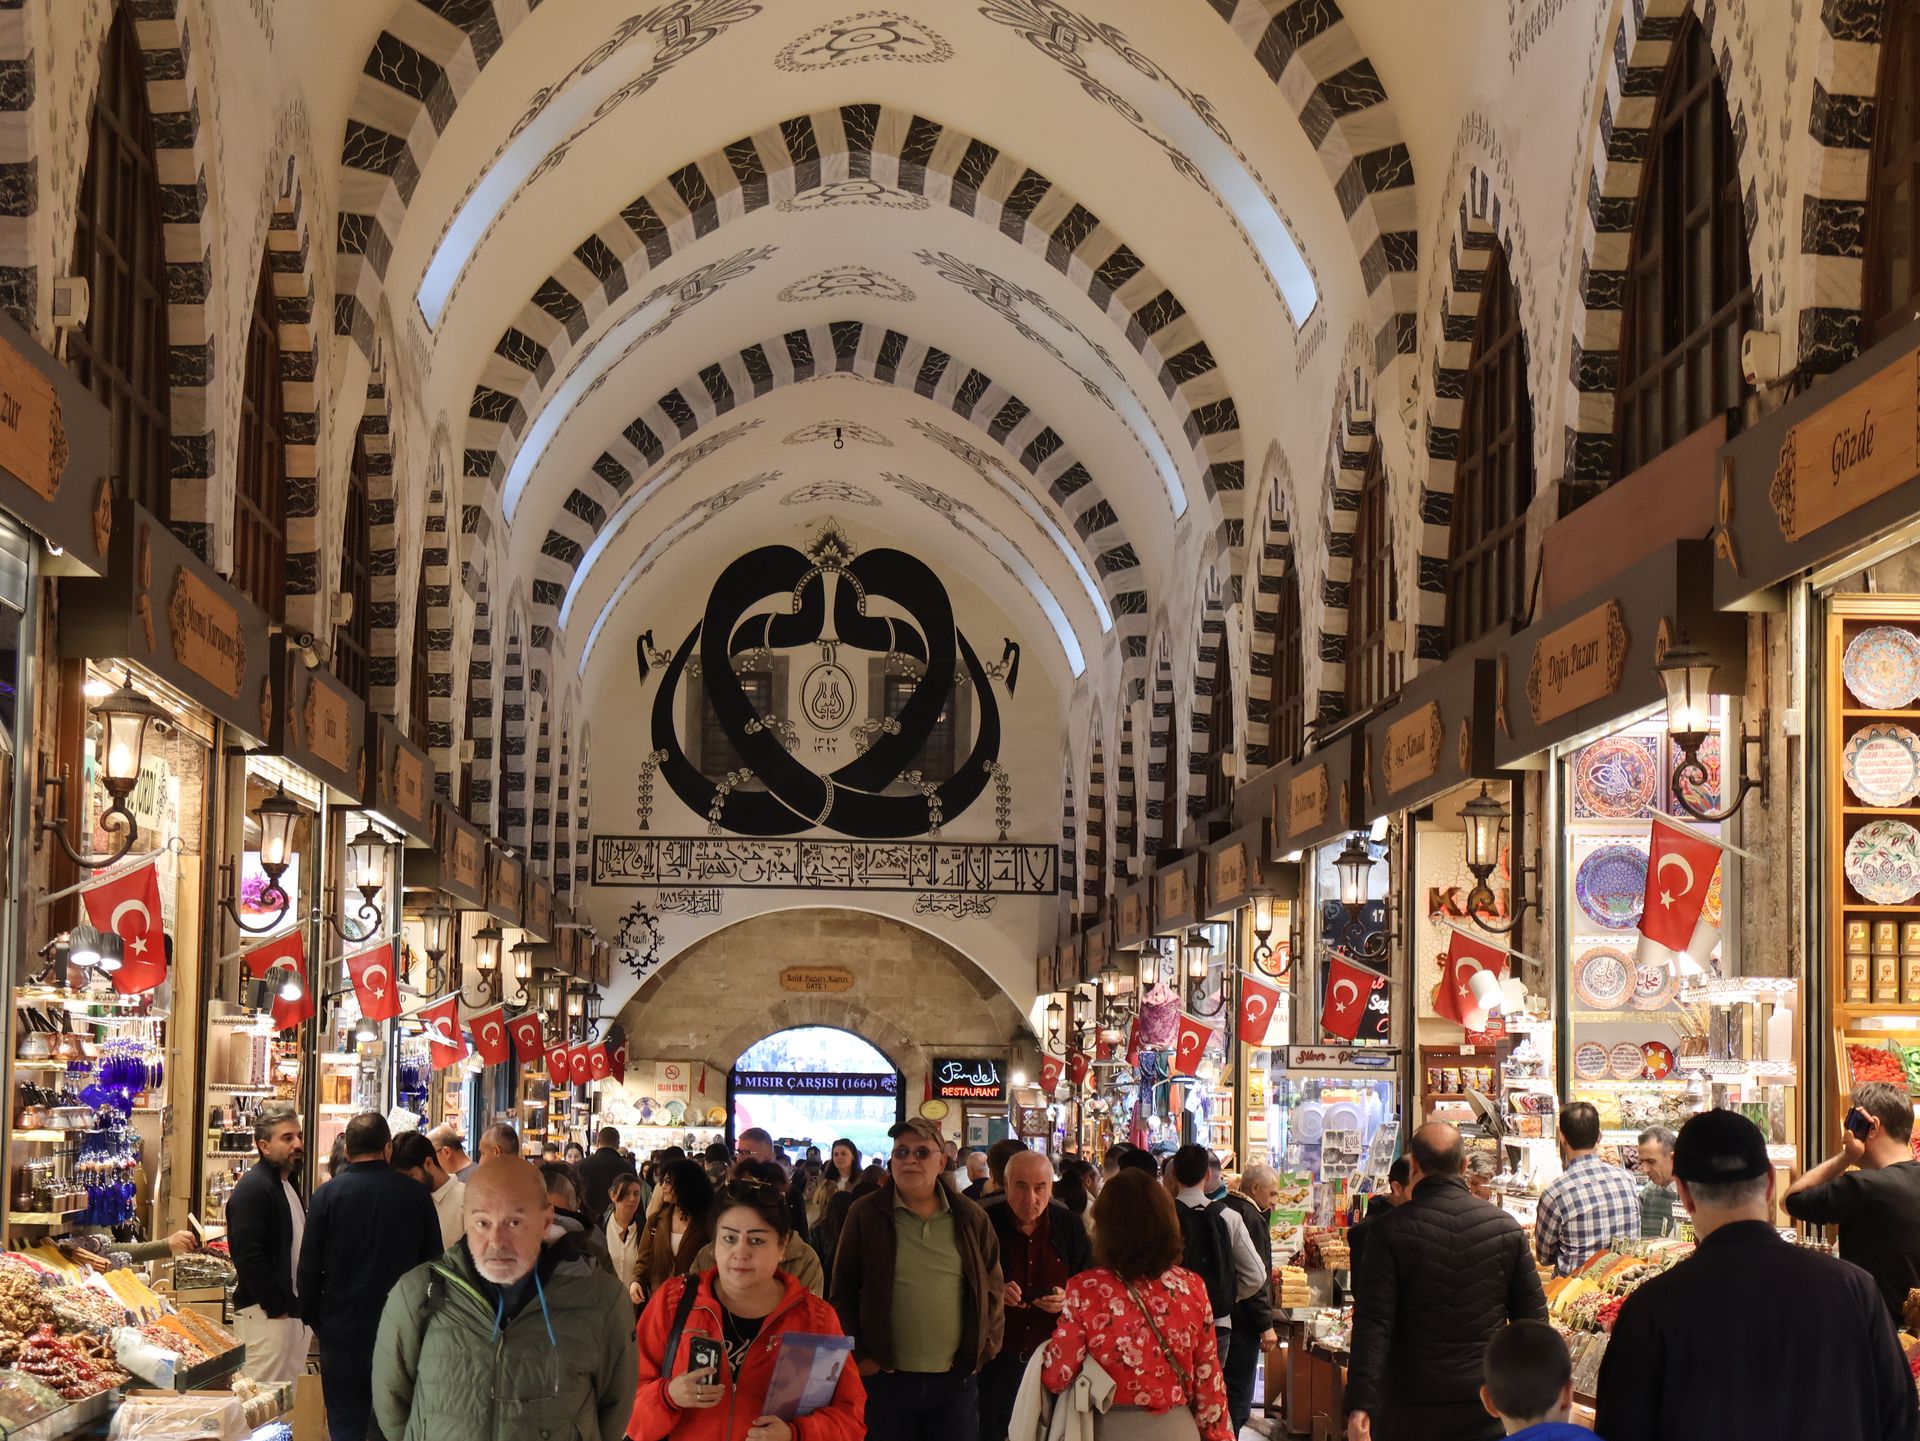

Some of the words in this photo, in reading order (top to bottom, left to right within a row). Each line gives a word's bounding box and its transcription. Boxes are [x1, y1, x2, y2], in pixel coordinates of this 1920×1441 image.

[1831, 408, 1875, 487] Gözde
[1547, 653, 1570, 694] Doğu
[1570, 640, 1599, 677] Pazarı
[1296, 1050, 1326, 1064] Silver
[939, 1061, 1000, 1086] Pandeli
[745, 1077, 784, 1088] MISIR
[786, 1077, 839, 1090] ÇARŞISI
[842, 1078, 878, 1090] (1664)
[941, 1087, 1000, 1097] RESTAURANT
